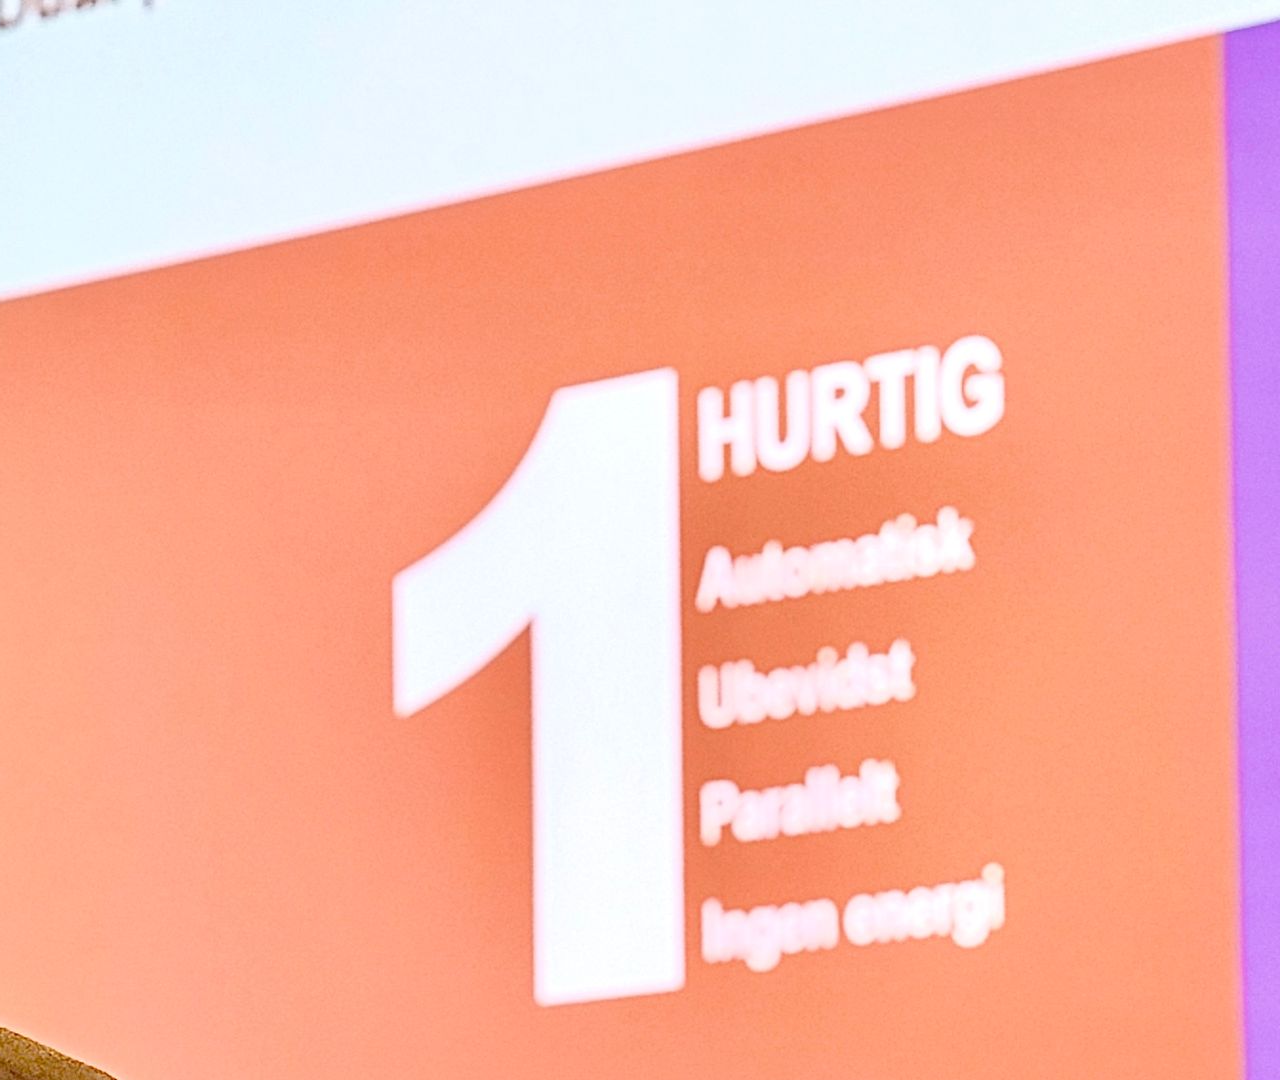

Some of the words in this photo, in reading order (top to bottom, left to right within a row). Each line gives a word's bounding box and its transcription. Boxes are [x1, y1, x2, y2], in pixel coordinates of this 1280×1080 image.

[696, 334, 1005, 483] HURTIG
[695, 505, 976, 612] Automatisk
[390, 366, 688, 1008] 1
[697, 638, 915, 730] Ubevidst
[699, 758, 900, 846] Parallelt
[700, 897, 839, 972] Ingen
[842, 862, 1006, 949] energi
